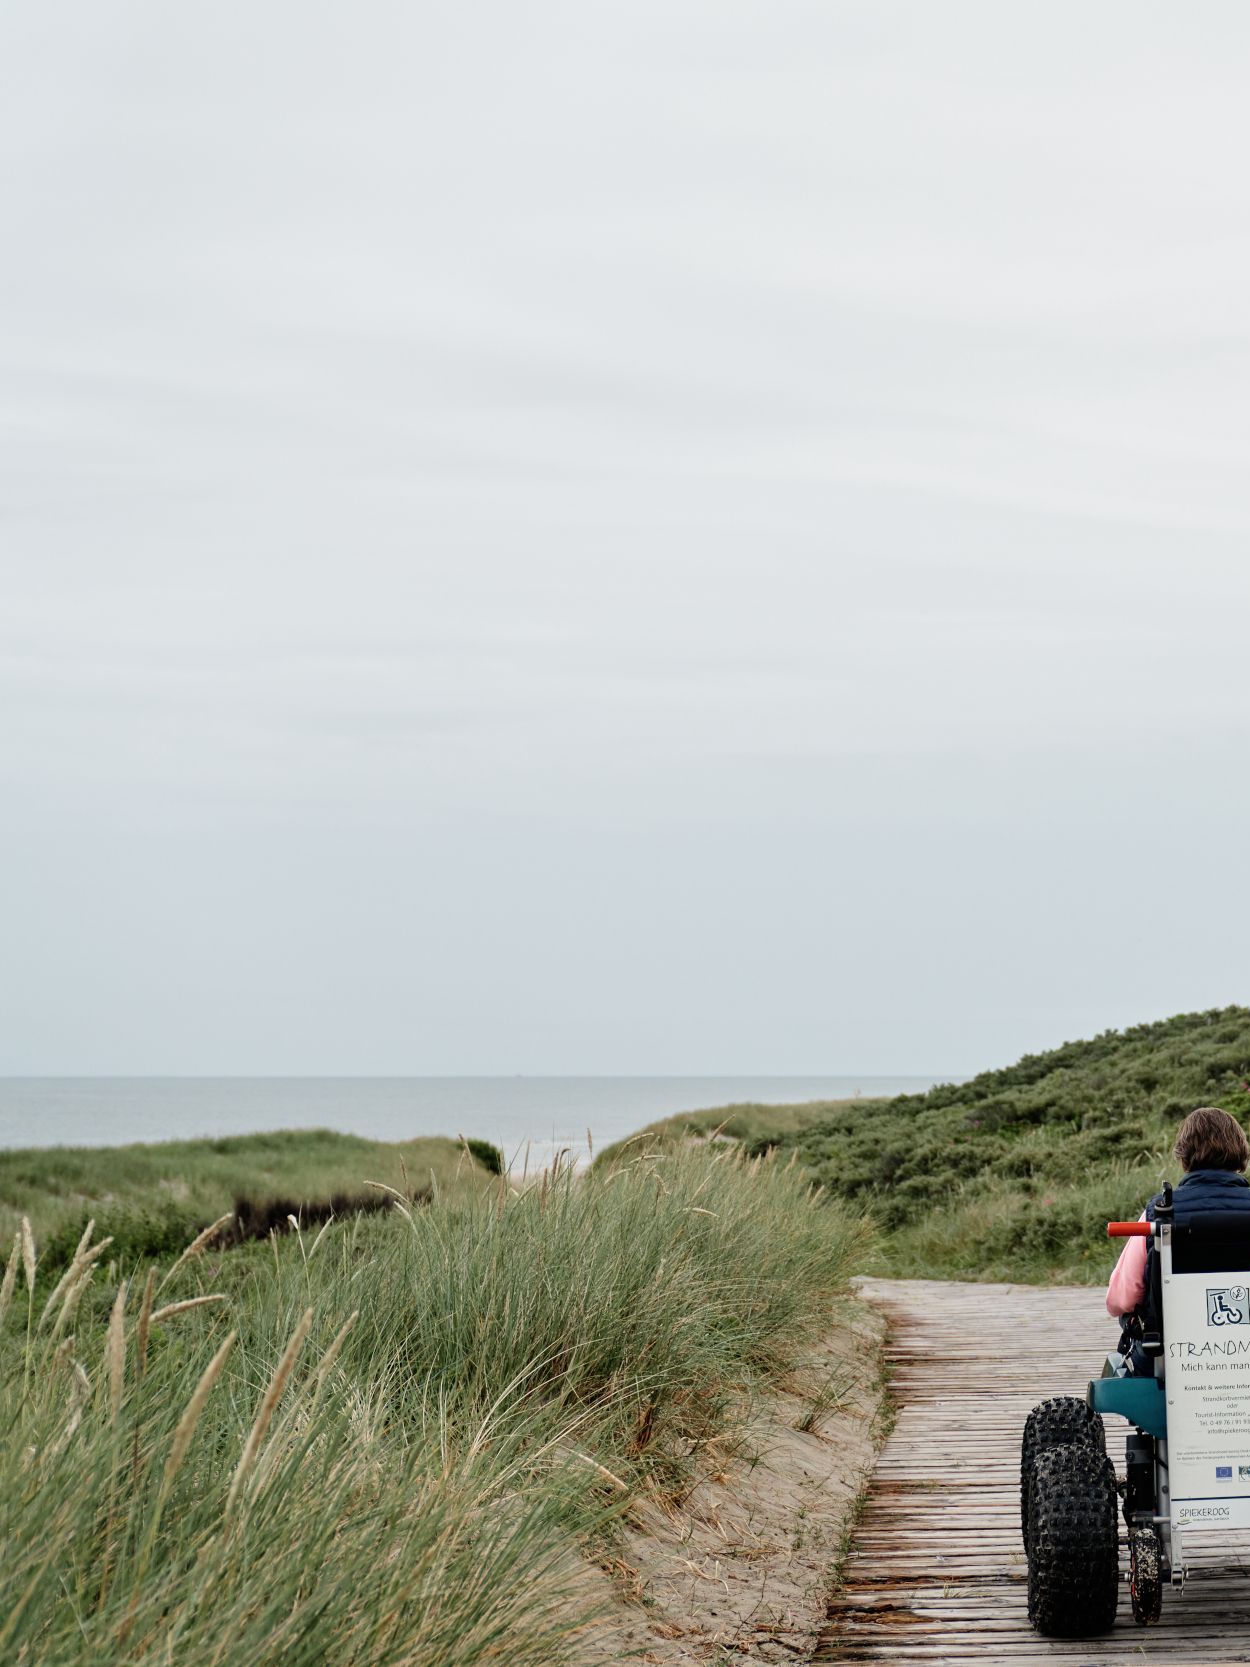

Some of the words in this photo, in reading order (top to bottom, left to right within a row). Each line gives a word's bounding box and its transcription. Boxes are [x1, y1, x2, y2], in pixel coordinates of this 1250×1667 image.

[1181, 1363, 1203, 1372] Mich
[1206, 1362, 1228, 1371] kann
[1179, 1507, 1230, 1517] SPIEKEROOG
